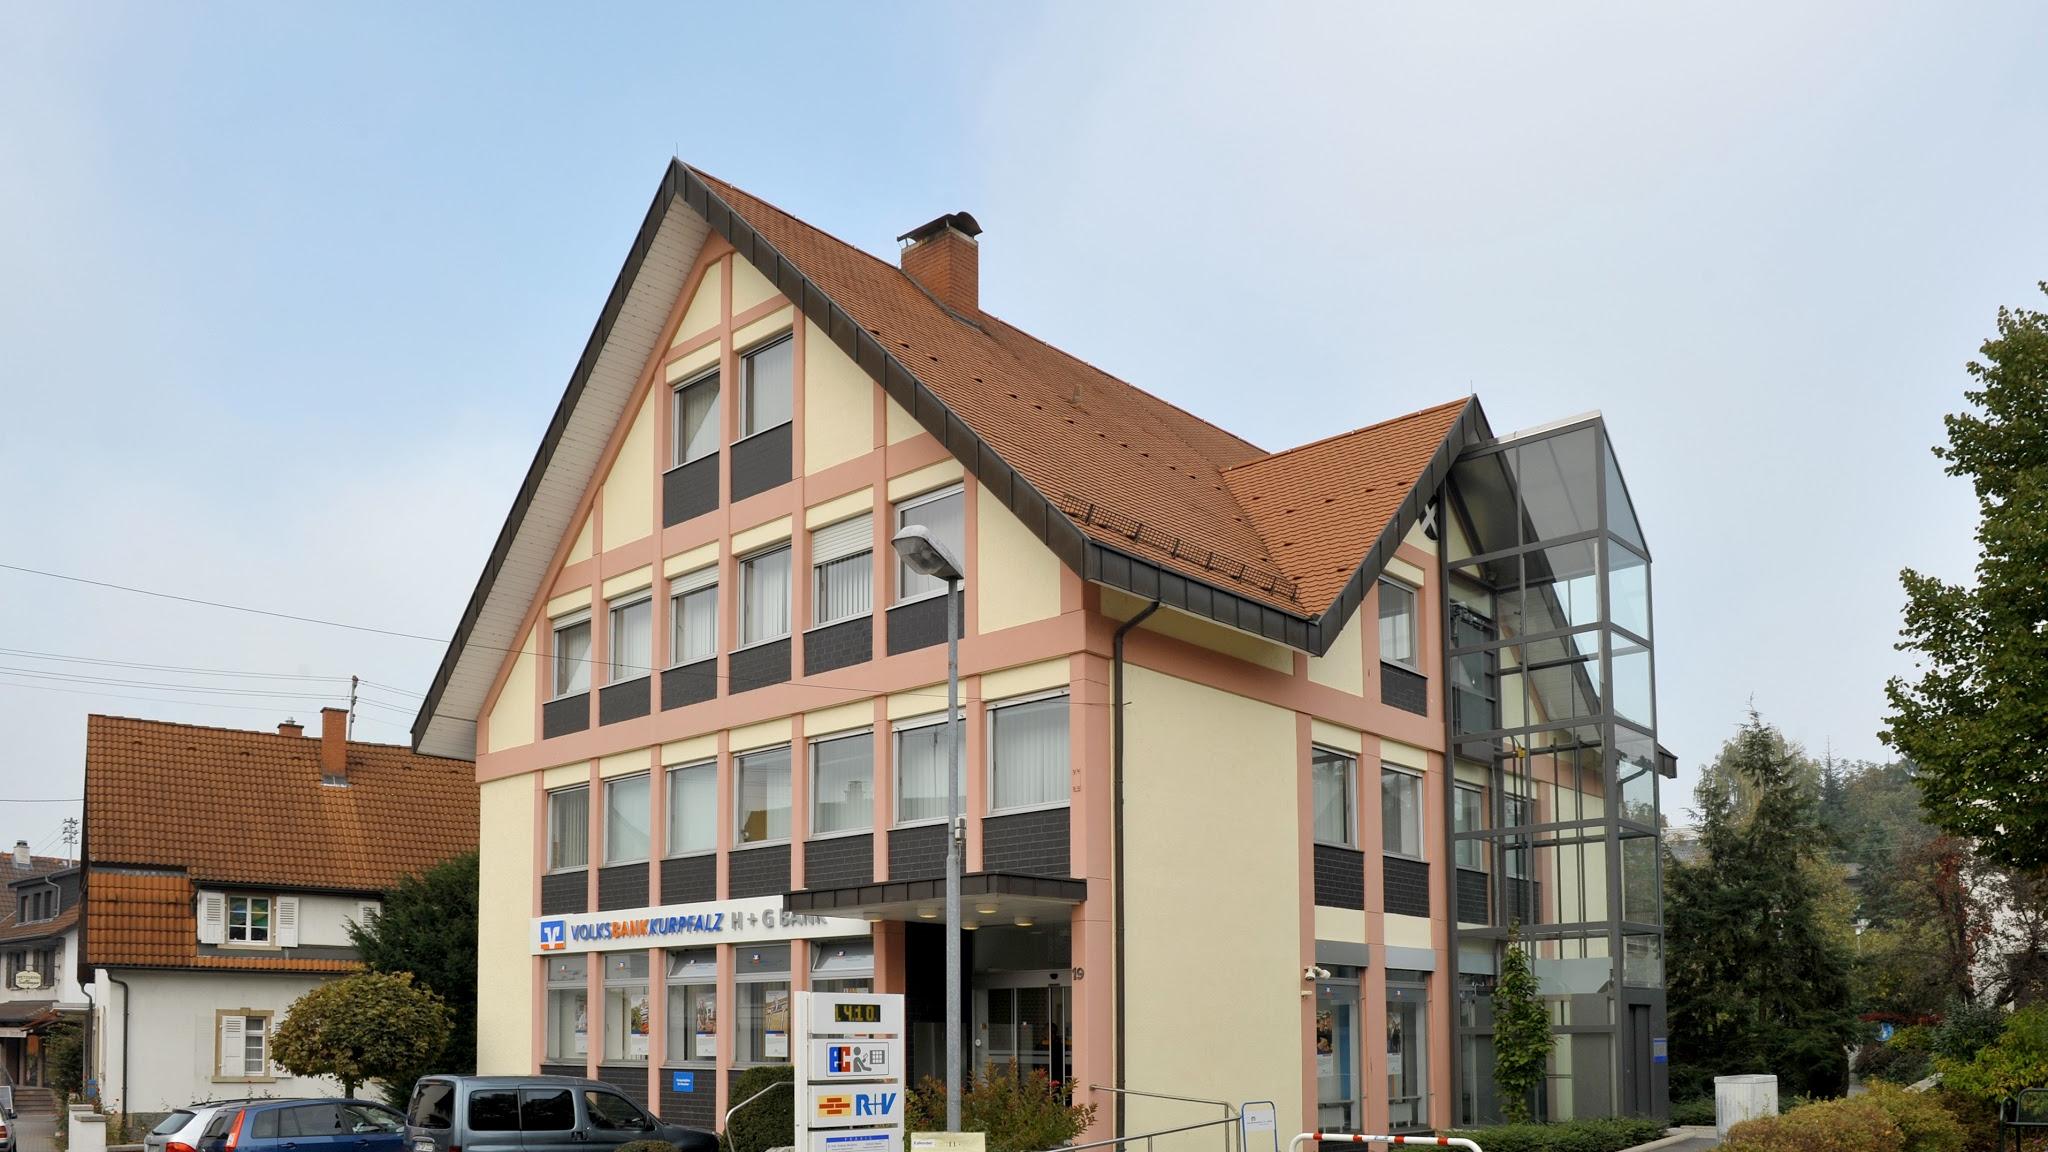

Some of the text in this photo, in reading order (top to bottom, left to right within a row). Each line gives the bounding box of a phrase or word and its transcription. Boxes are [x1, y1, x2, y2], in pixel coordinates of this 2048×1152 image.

[731, 911, 743, 930] H
[762, 909, 775, 928] G
[1072, 967, 1085, 980] 19
[856, 1092, 897, 1116] R+V
